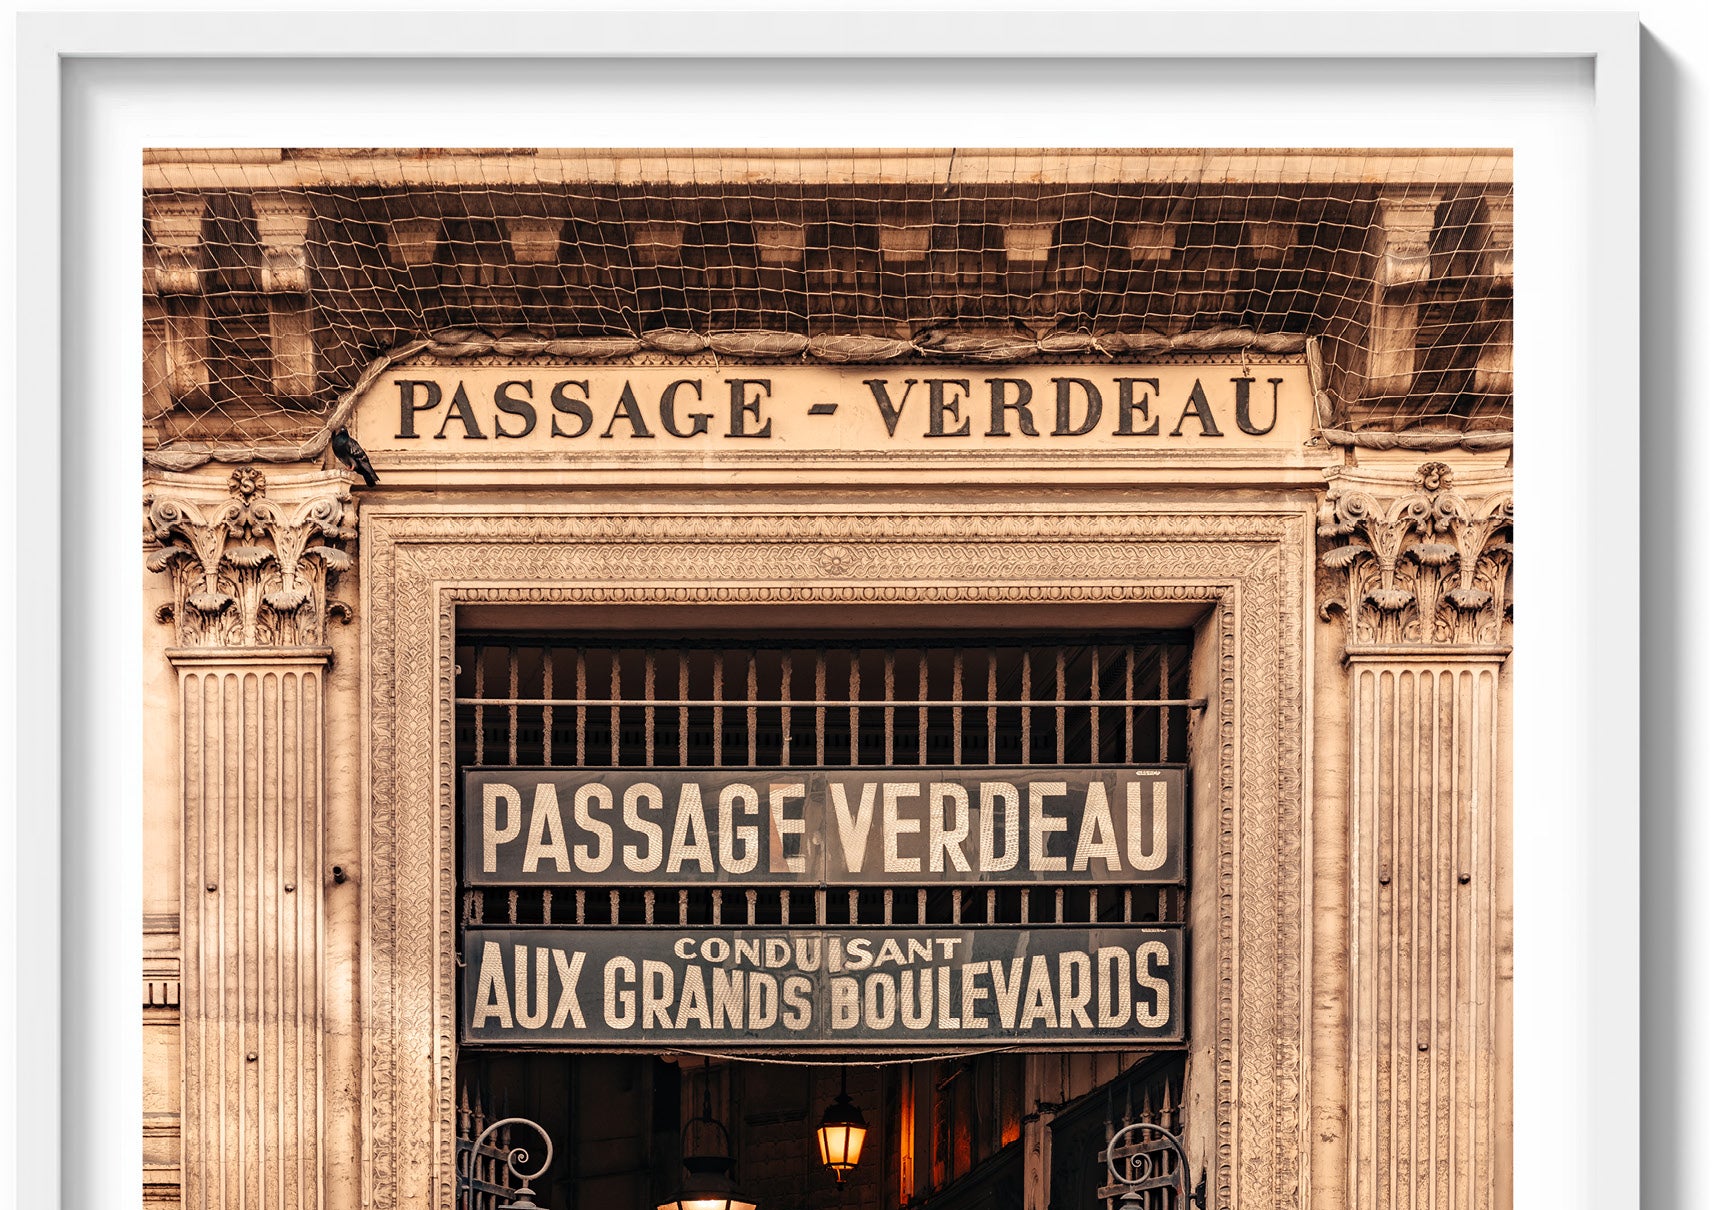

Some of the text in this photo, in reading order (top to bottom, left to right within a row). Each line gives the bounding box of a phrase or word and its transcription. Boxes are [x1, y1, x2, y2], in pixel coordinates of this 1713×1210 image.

[394, 375, 1284, 440] PASSAGE - VERDEAU
[482, 780, 1168, 874] PASSAGE VERDEAU
[472, 940, 1171, 1031] AUX GRANDS BOULEVARDS
[673, 937, 962, 973] CONDUISANT
